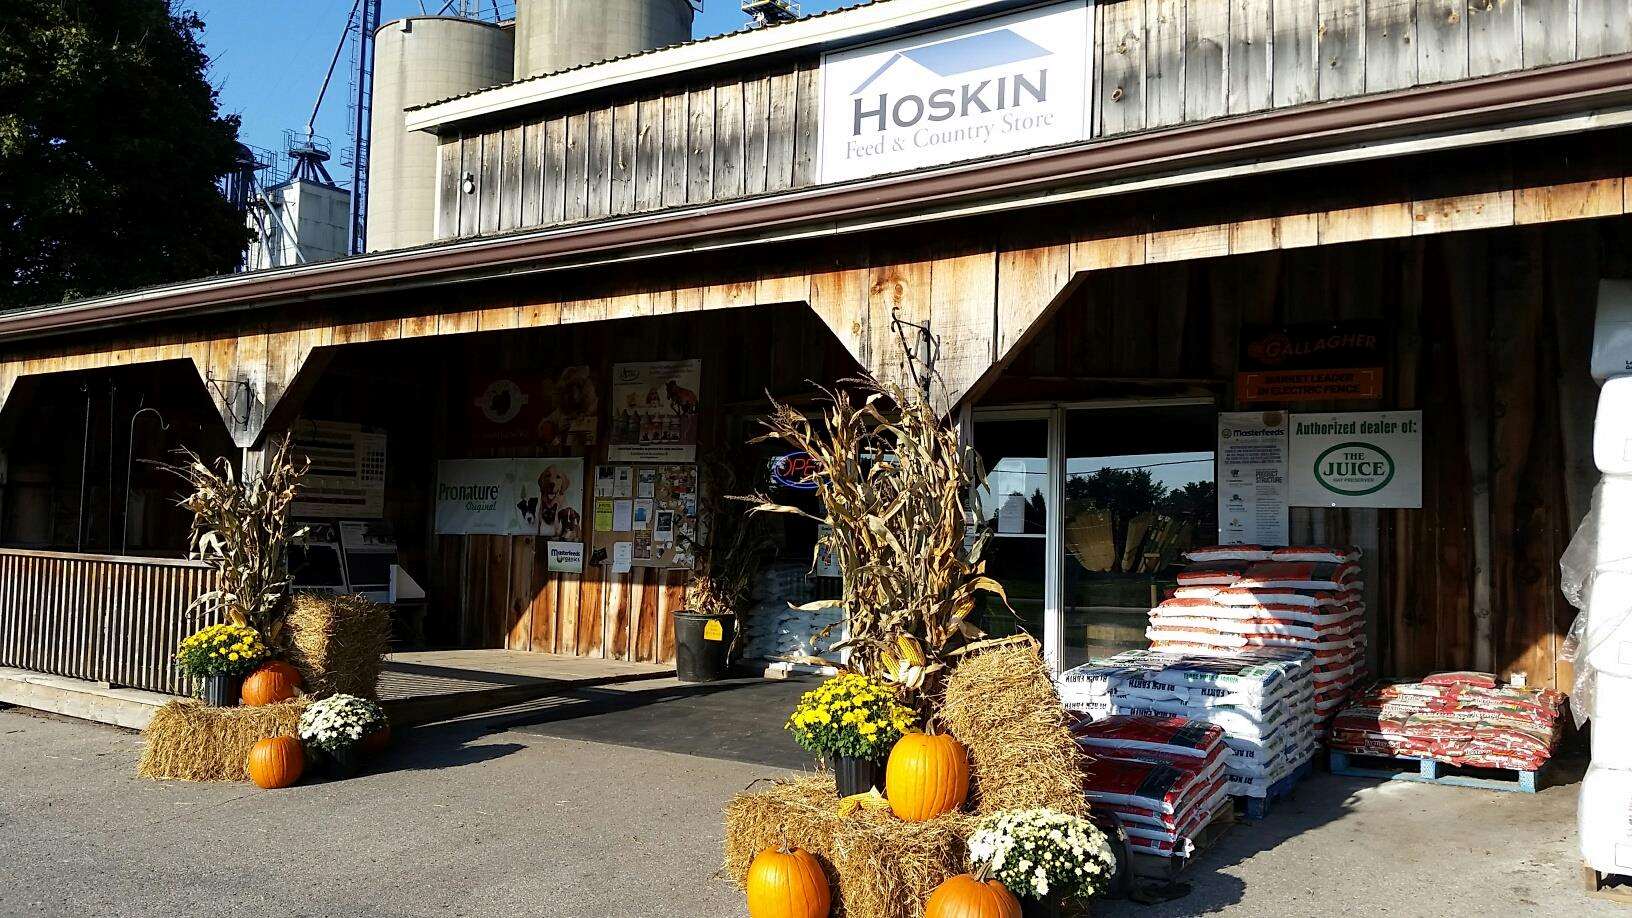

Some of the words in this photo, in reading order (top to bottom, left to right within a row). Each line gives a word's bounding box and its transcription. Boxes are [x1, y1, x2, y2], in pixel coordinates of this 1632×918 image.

[853, 68, 1048, 136] HOSKIN
[846, 136, 884, 159] Feed
[892, 138, 905, 152] &
[913, 121, 995, 149] Country
[1001, 112, 1054, 134] Store
[1265, 334, 1377, 357] GALLAGHER
[1265, 374, 1308, 384] MARKET
[1310, 373, 1354, 383] LEADER
[1257, 387, 1269, 396] IN
[1271, 386, 1323, 396] ELECTRIC
[1324, 384, 1361, 395] FENCE
[1233, 428, 1285, 437] Masterfeeds
[1295, 421, 1356, 435] Authorized
[1360, 420, 1397, 435] dealer
[1401, 419, 1417, 434] of:
[1343, 452, 1366, 460] THE
[1323, 461, 1386, 476] JUICE
[438, 483, 499, 501] Pronature
[465, 501, 497, 513] Original
